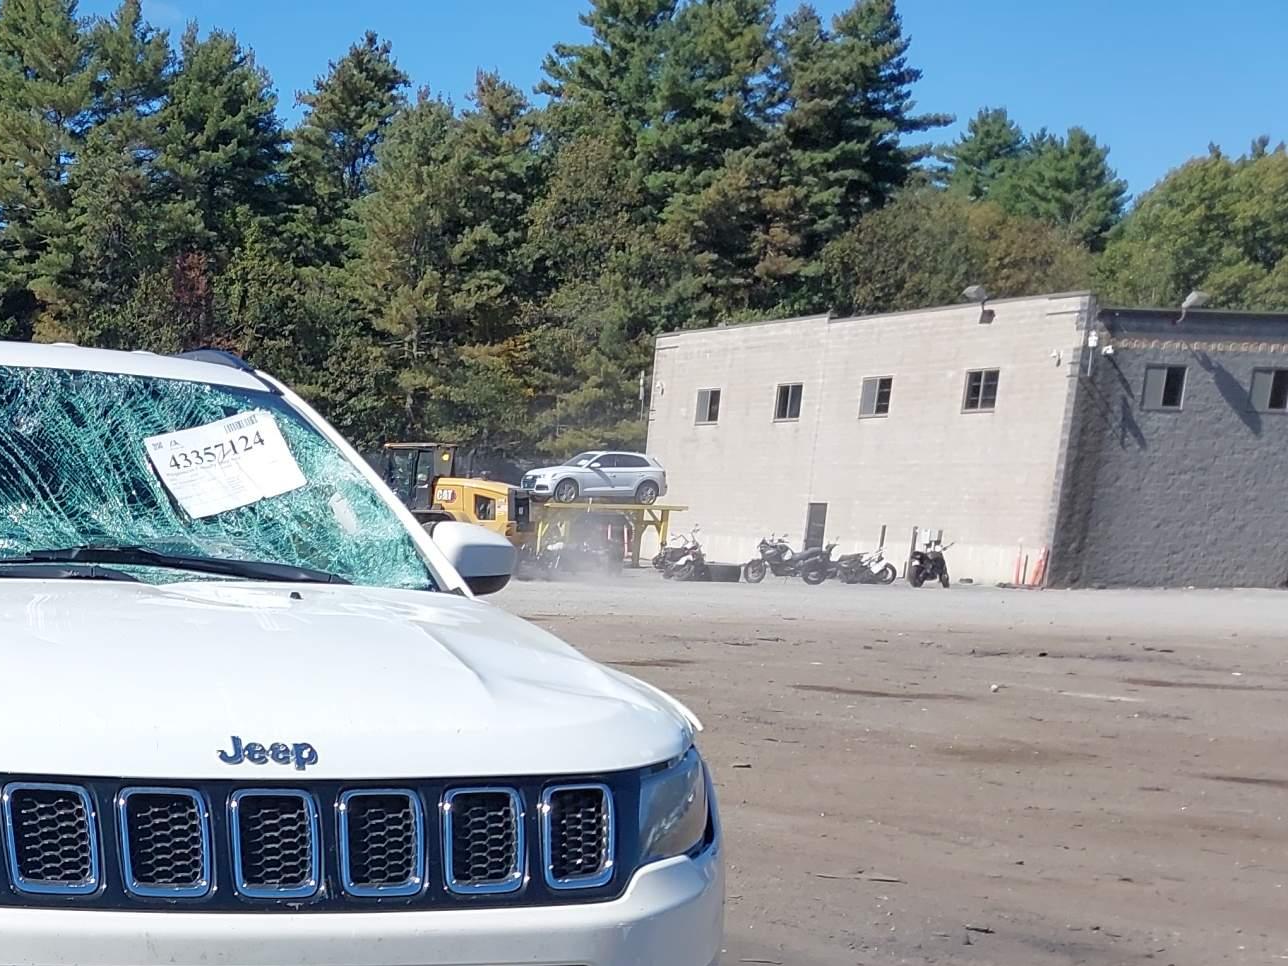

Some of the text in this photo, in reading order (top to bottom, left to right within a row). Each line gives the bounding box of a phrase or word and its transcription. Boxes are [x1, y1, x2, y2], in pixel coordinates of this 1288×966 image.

[169, 430, 265, 470] 43357124
[436, 489, 453, 501] CAT
[216, 735, 319, 771] Jeep
